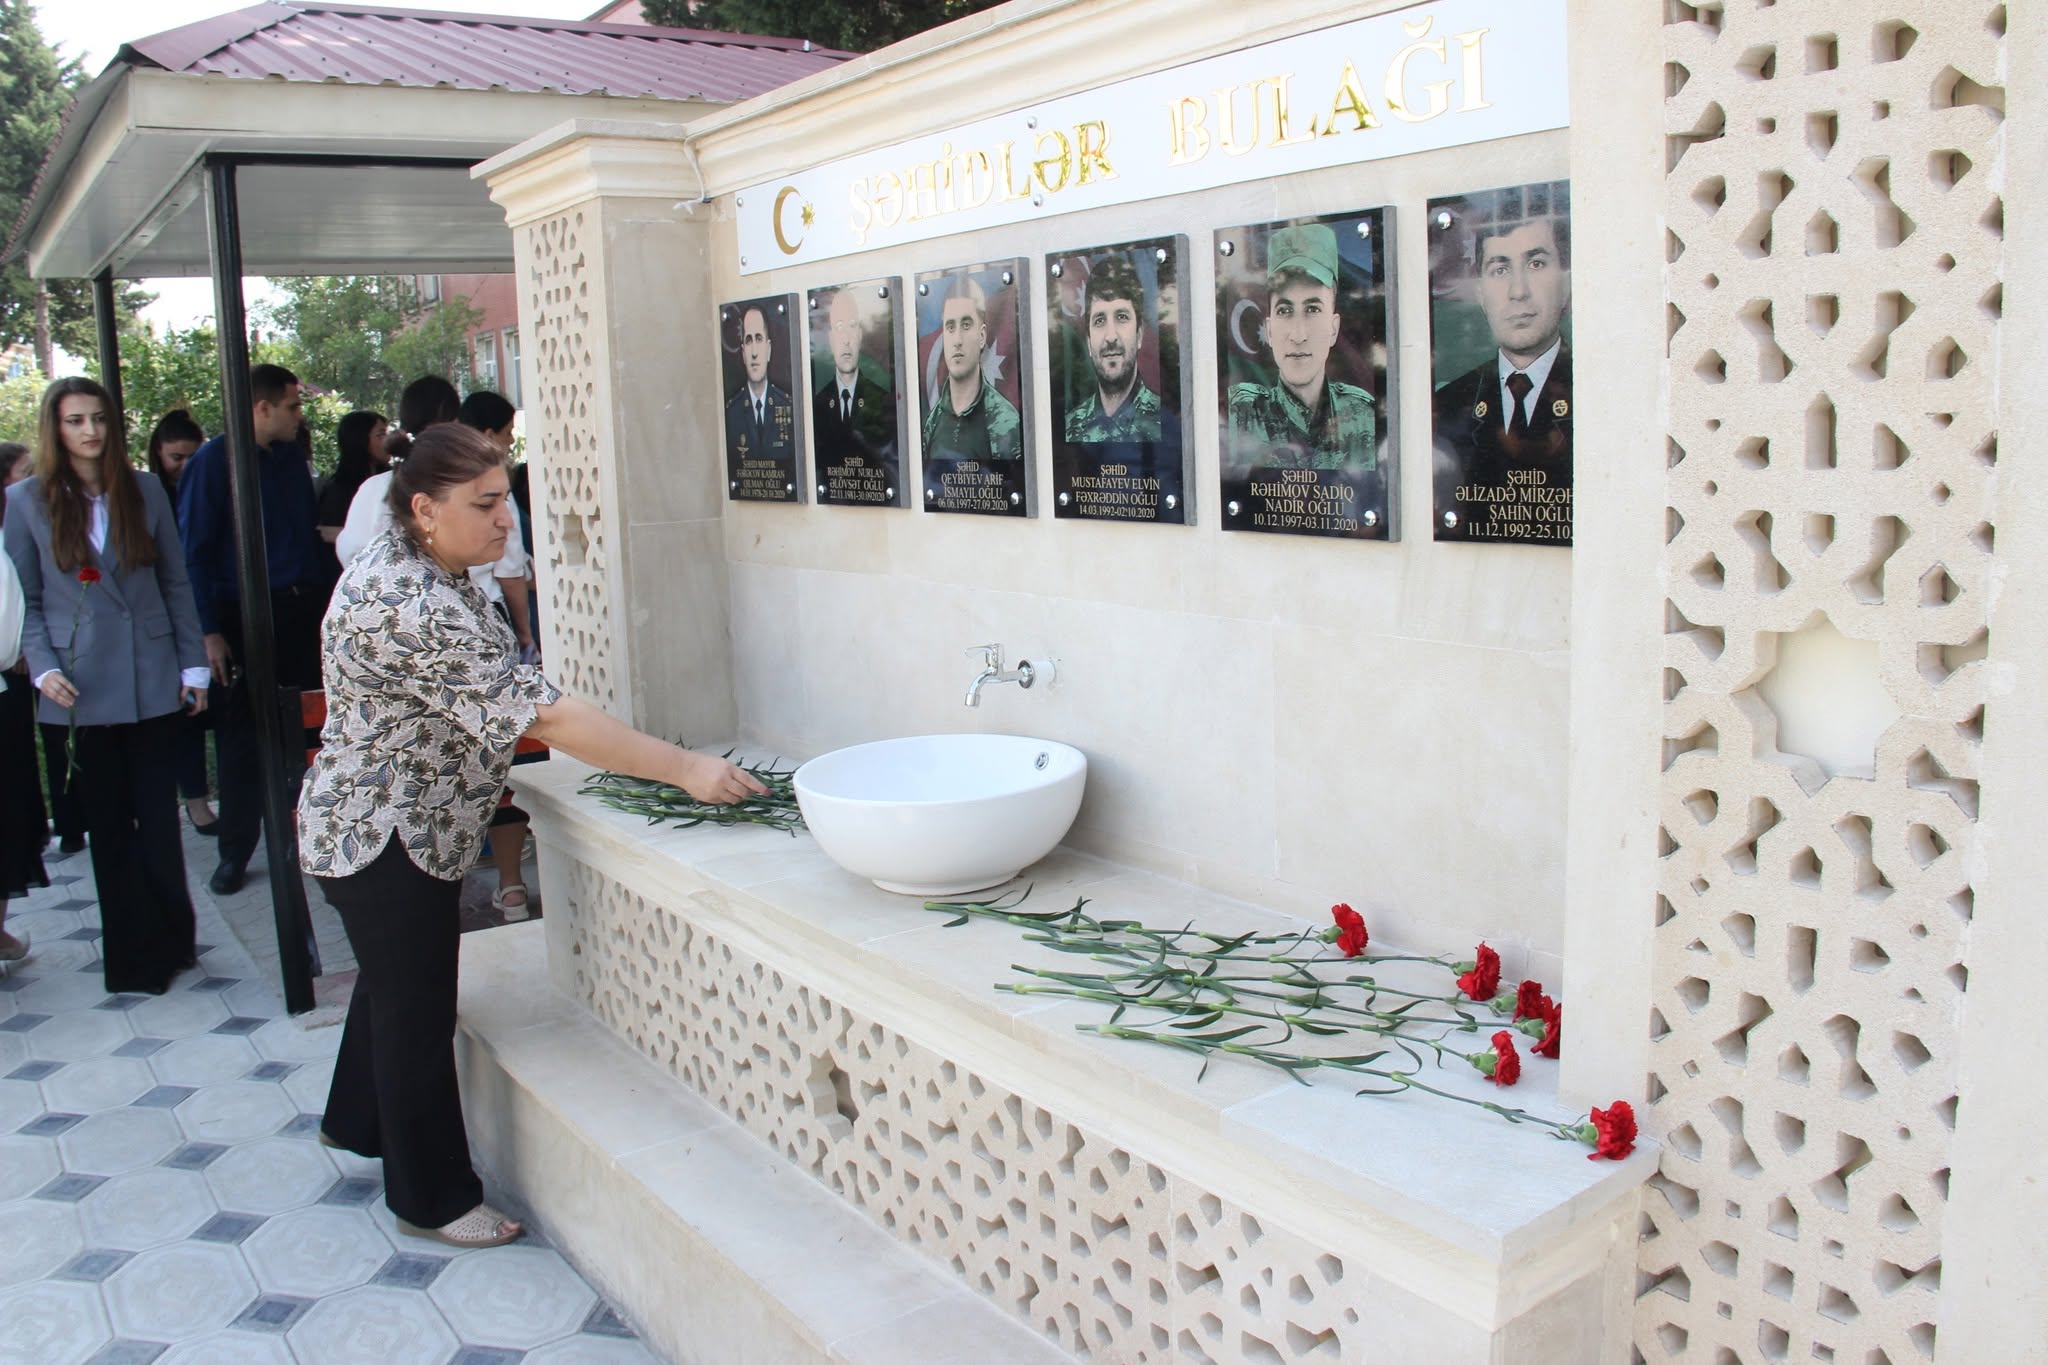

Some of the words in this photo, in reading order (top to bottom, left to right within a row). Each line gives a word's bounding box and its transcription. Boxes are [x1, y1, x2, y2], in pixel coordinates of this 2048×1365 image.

[849, 119, 1120, 246] ŞƏHİDLƏR
[1166, 15, 1494, 167] BULAĞI
[844, 456, 864, 467] ŞƏHİD
[956, 460, 980, 473] ŞƏHİD
[857, 467, 885, 478] NURLAN
[1100, 463, 1127, 477] ŞƏHİD
[1282, 469, 1317, 485] ŞƏHİD
[1507, 468, 1546, 487] ŞƏHİD
[765, 478, 781, 489] OĞLU
[829, 477, 861, 490] ƏLÖVSƏT
[863, 478, 884, 491] OĞLU
[941, 473, 983, 486] QEYBİYEV
[984, 472, 1004, 485] ARİF
[1071, 476, 1130, 489] MUSTAFAYEV
[1131, 476, 1160, 490] ELVİN
[978, 485, 1003, 500] OĞLU
[1075, 491, 1129, 505] FƏXRƏDDİN
[1130, 492, 1158, 506] OĞLU
[1250, 481, 1310, 498] RƏHİMOV
[1313, 483, 1354, 503] SADİQ
[1455, 484, 1516, 503] ƏLİZADƏ
[1265, 498, 1305, 514] NADİR
[1308, 499, 1345, 516] OĞLU
[1489, 503, 1532, 523] ŞAHİN
[1535, 504, 1574, 523] OĞLU
[1254, 513, 1358, 531] 10.12.1997-03.11.2020
